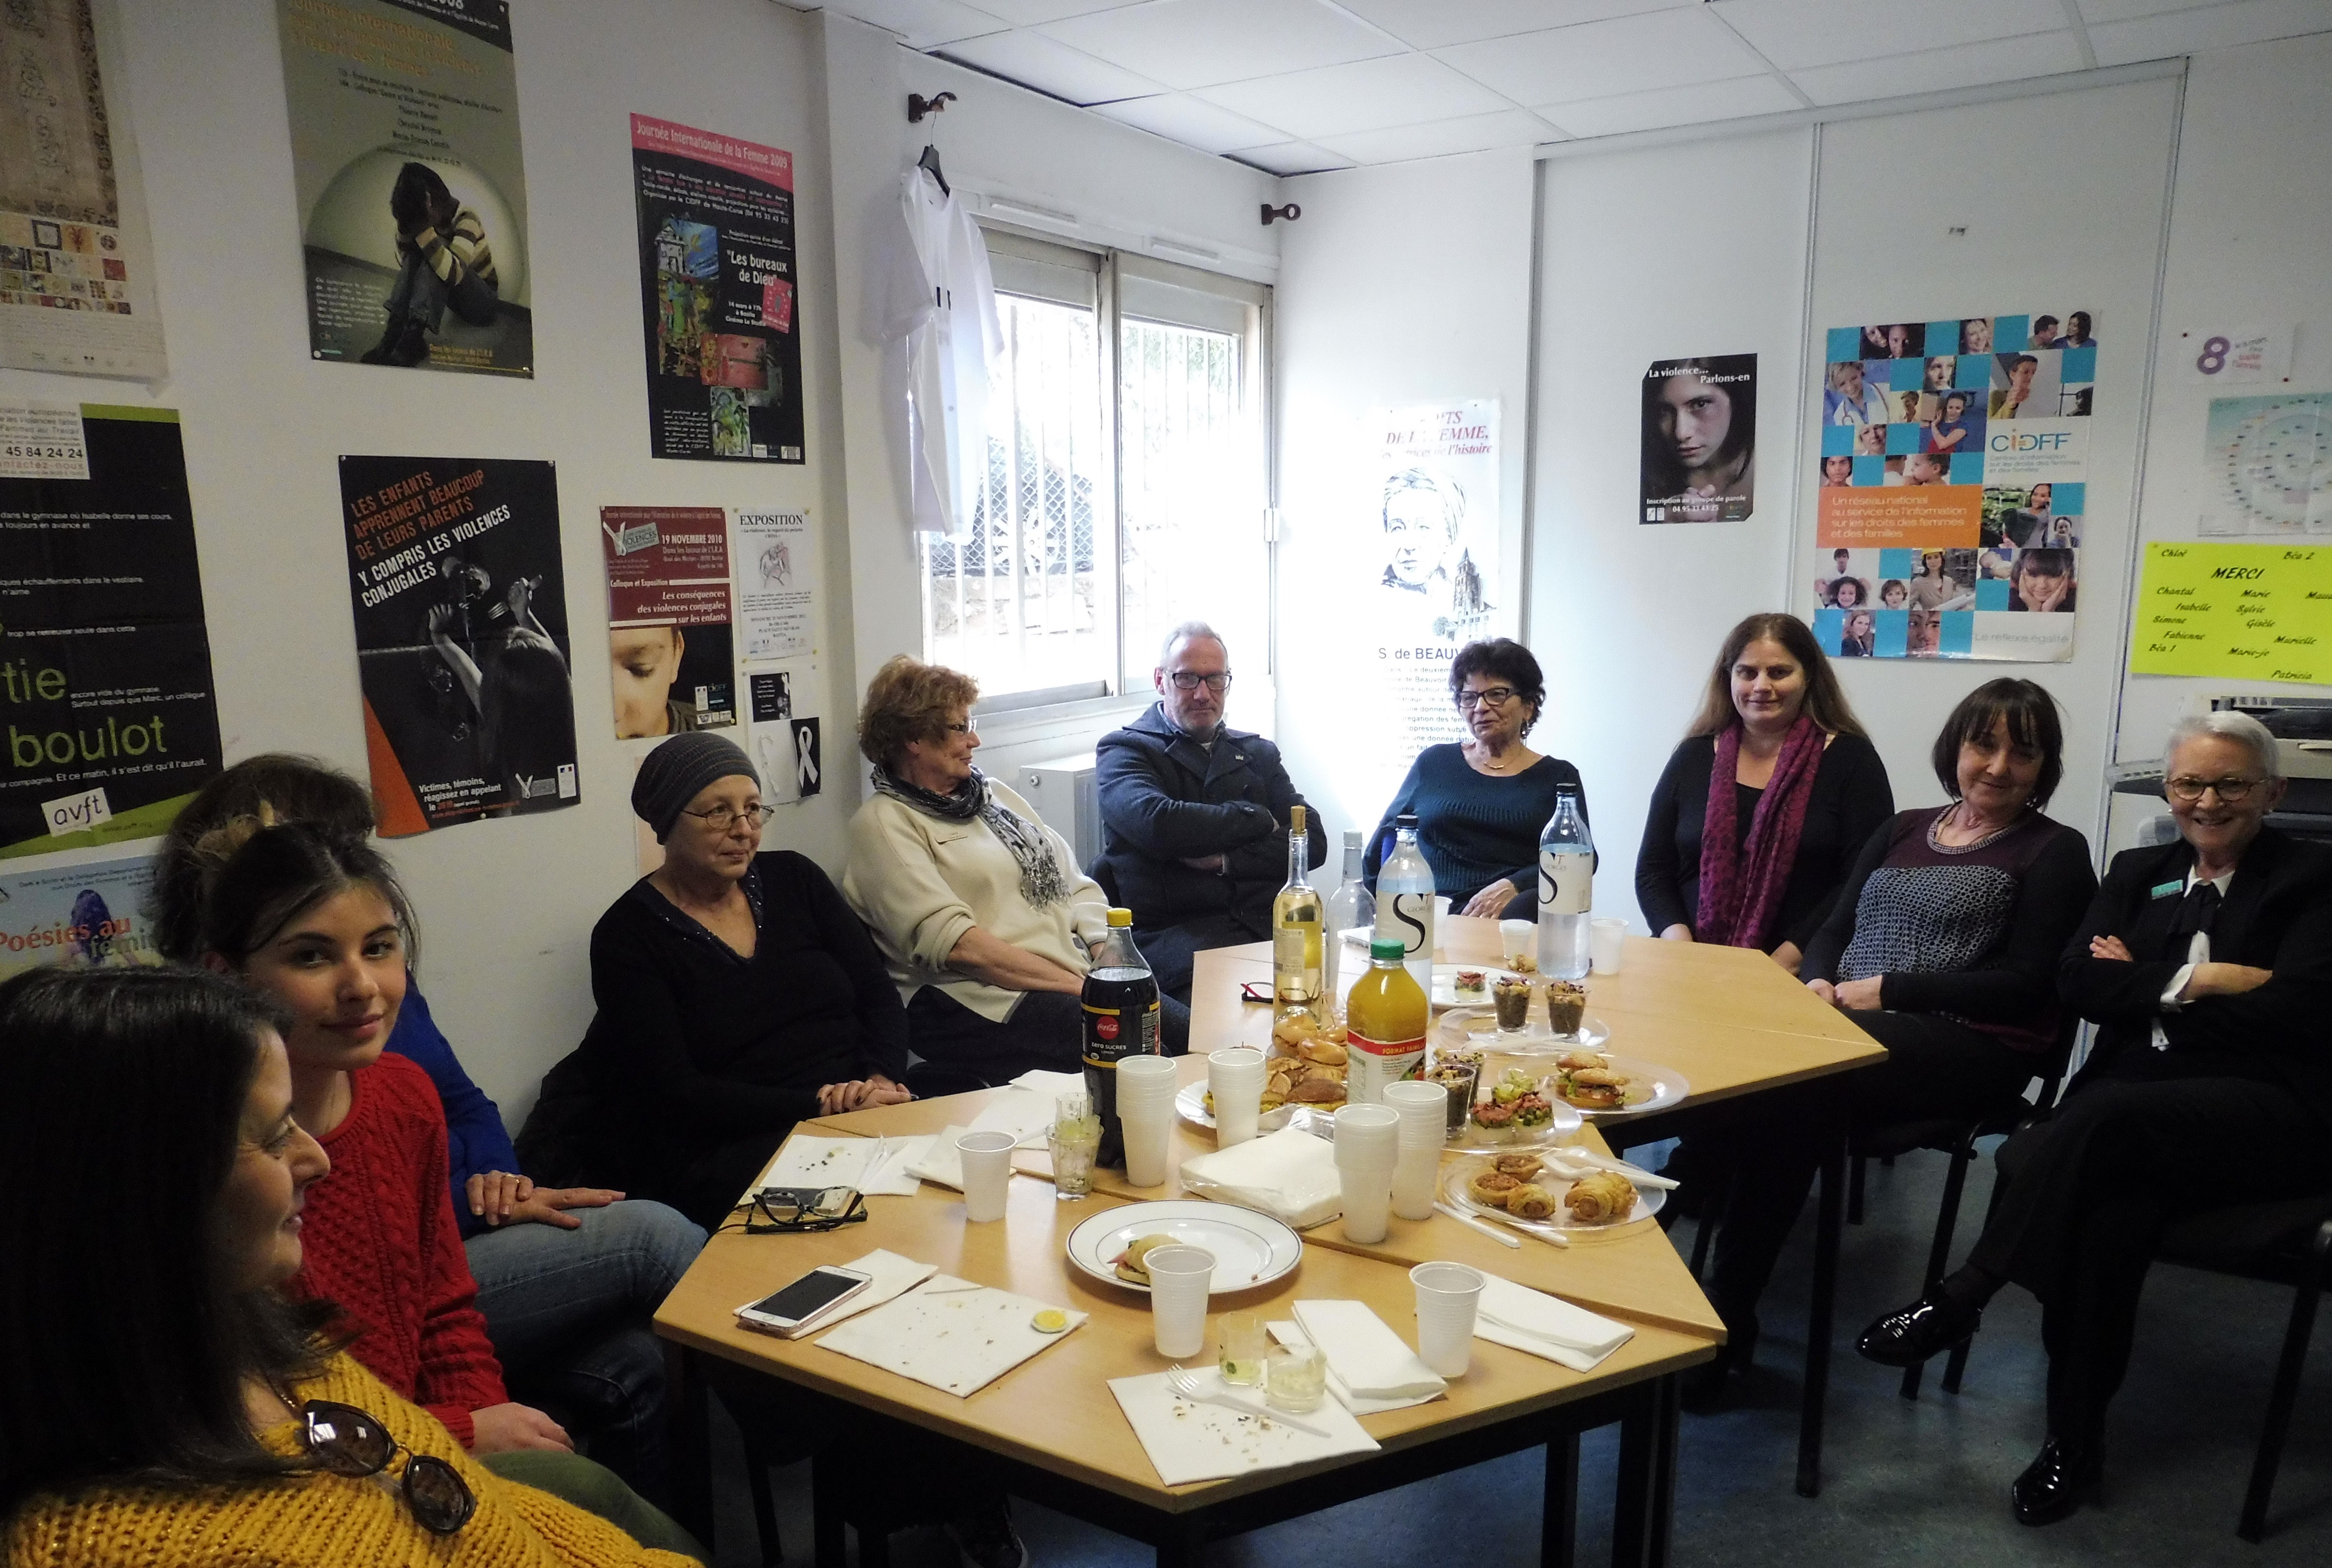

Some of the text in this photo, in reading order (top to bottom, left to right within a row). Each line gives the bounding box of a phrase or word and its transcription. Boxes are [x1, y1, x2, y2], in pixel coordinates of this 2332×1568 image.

[671, 130, 723, 153] Internationale
[725, 142, 733, 156] de
[735, 145, 741, 158] la
[743, 147, 768, 164] Femme
[727, 250, 787, 273] "Les bureaux
[739, 269, 750, 282] de
[2197, 336, 2230, 375] 8
[1649, 367, 1709, 378] La violence...
[1701, 375, 1751, 384] Parlons-en
[1440, 426, 1489, 441] EMME,
[6, 446, 83, 458] 45 84 24 24
[1448, 443, 1492, 455] l'histoire
[351, 471, 434, 517] LES ENFANTS
[353, 469, 485, 539] APPRENNENT BEAUCOUP
[1832, 496, 1928, 505] Un réseau national
[1901, 507, 1966, 515] l'information
[740, 515, 803, 525] EXPOSITION
[1920, 518, 1965, 526] femmes
[355, 496, 475, 561] DE LEURS PARENTS
[1843, 529, 1862, 537] des
[1864, 529, 1903, 537] familles
[358, 504, 511, 586] Y COMPRIS LES VIOLENCES
[662, 535, 722, 544] 19 NOVEMBRE 2010
[2211, 568, 2265, 579] MERCI
[361, 561, 437, 608] CONJUGALES
[610, 579, 633, 588] Colloque
[642, 579, 668, 587] Exposition
[676, 590, 726, 601] conséquences
[2157, 587, 2196, 595] Chantal
[2241, 589, 2271, 598] Marie
[637, 602, 726, 613] des violences conjugales
[2176, 603, 2211, 612] Isabelle
[2236, 605, 2266, 615] Sylvie
[701, 613, 727, 622] enfants
[2153, 616, 2187, 624] Simone
[2164, 631, 2206, 641] Fabienne
[2274, 636, 2317, 645] Marielle
[1395, 648, 1410, 659] de
[1, 658, 67, 703] tie
[2272, 670, 2312, 680] Patricia
[9, 715, 167, 767] boulot
[57, 772, 66, 782] Et
[68, 772, 80, 780] ce
[119, 765, 140, 775] s'est
[156, 762, 174, 772] qu'il
[419, 777, 485, 794] Victimes, témoins,
[424, 791, 458, 802] réagissez
[471, 783, 502, 796] appelant
[54, 795, 102, 825] avft
[0, 917, 131, 952] Poésies au
